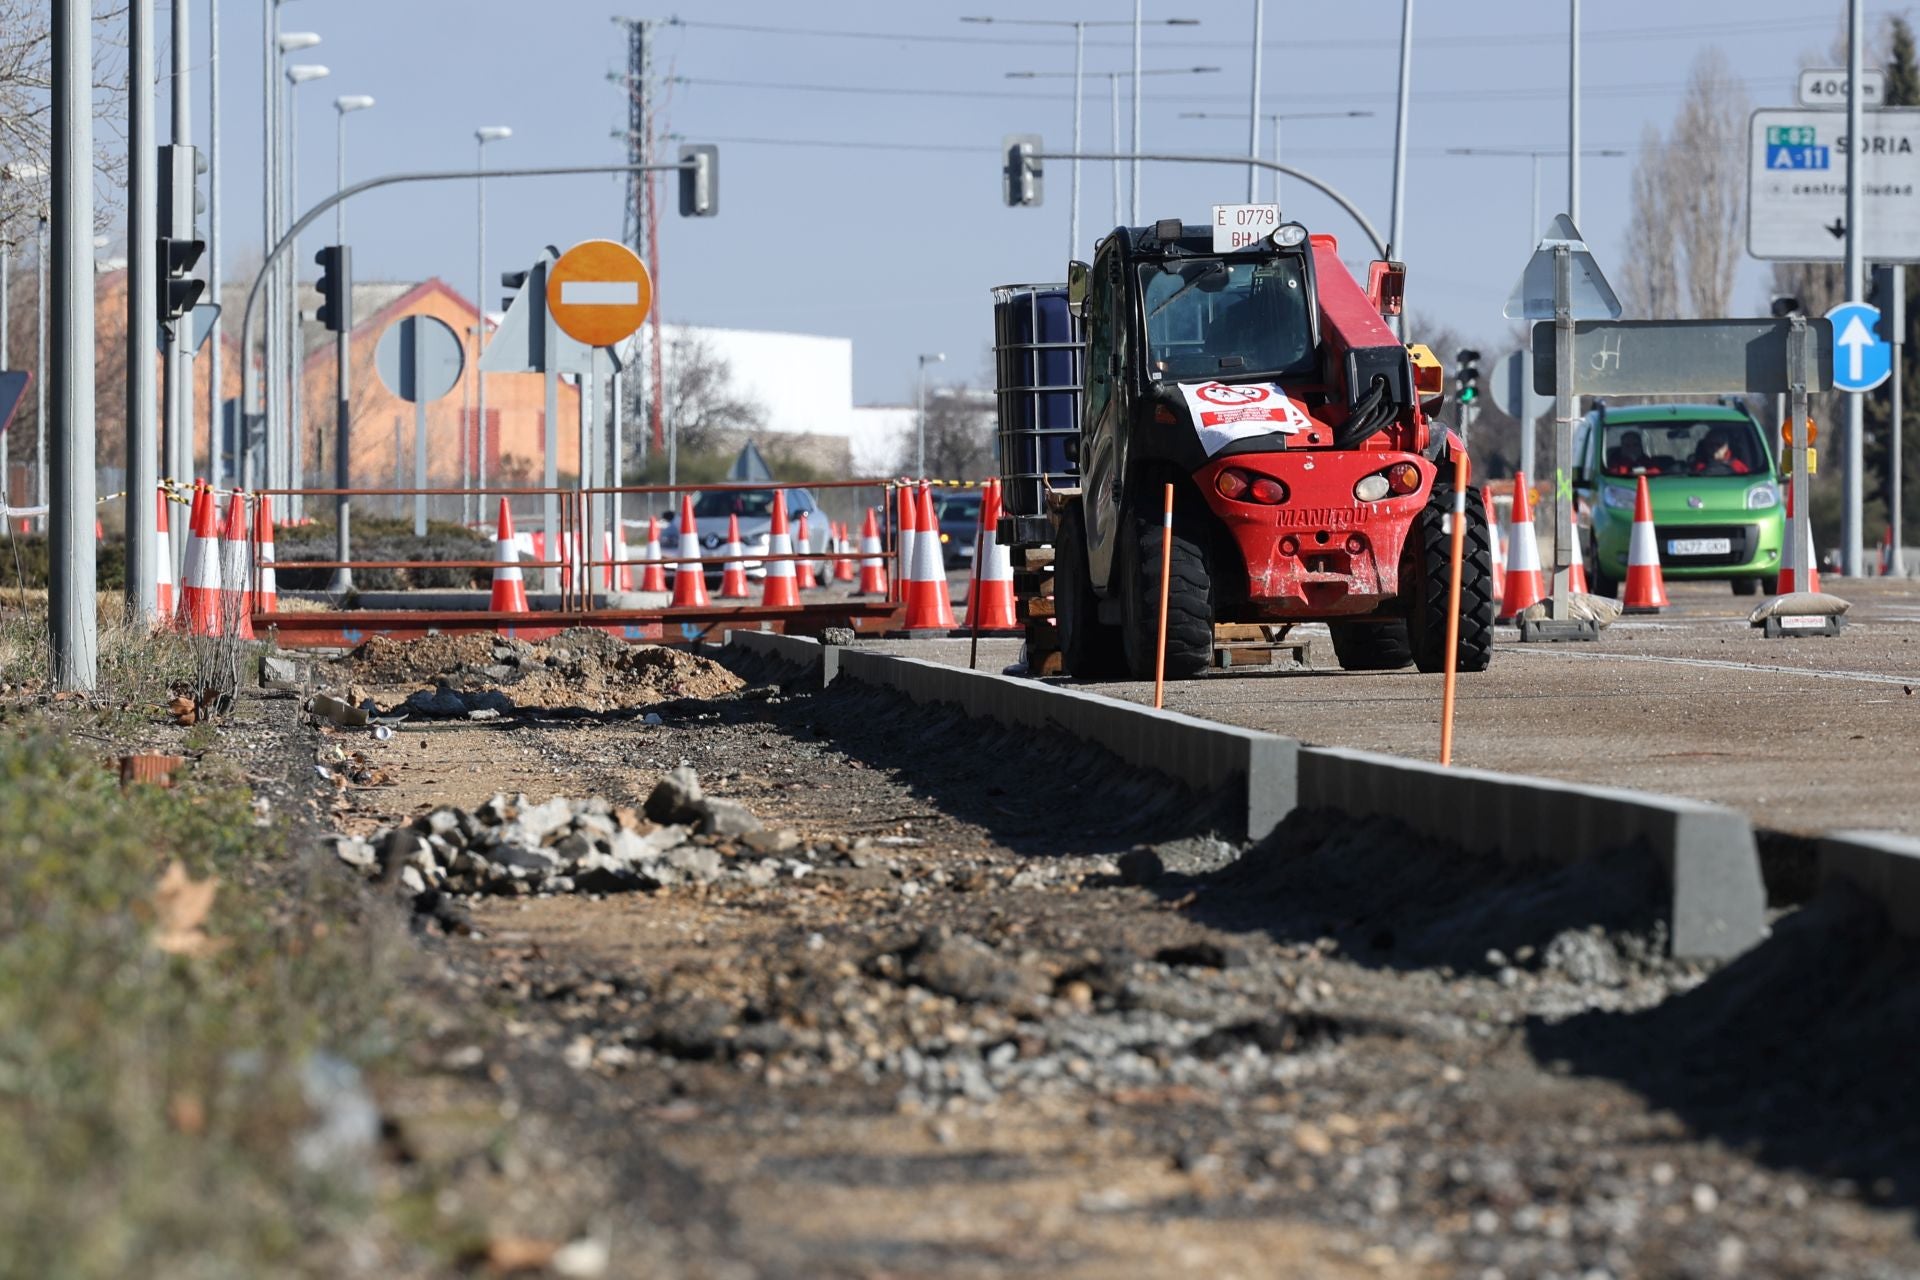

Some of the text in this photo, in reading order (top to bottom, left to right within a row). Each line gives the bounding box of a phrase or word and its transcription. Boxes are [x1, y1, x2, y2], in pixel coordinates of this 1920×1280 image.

[1773, 147, 1822, 167] A-11
[1218, 209, 1274, 226] E 0779
[1232, 231, 1260, 247] BHJ
[1276, 507, 1369, 527] MANITOU
